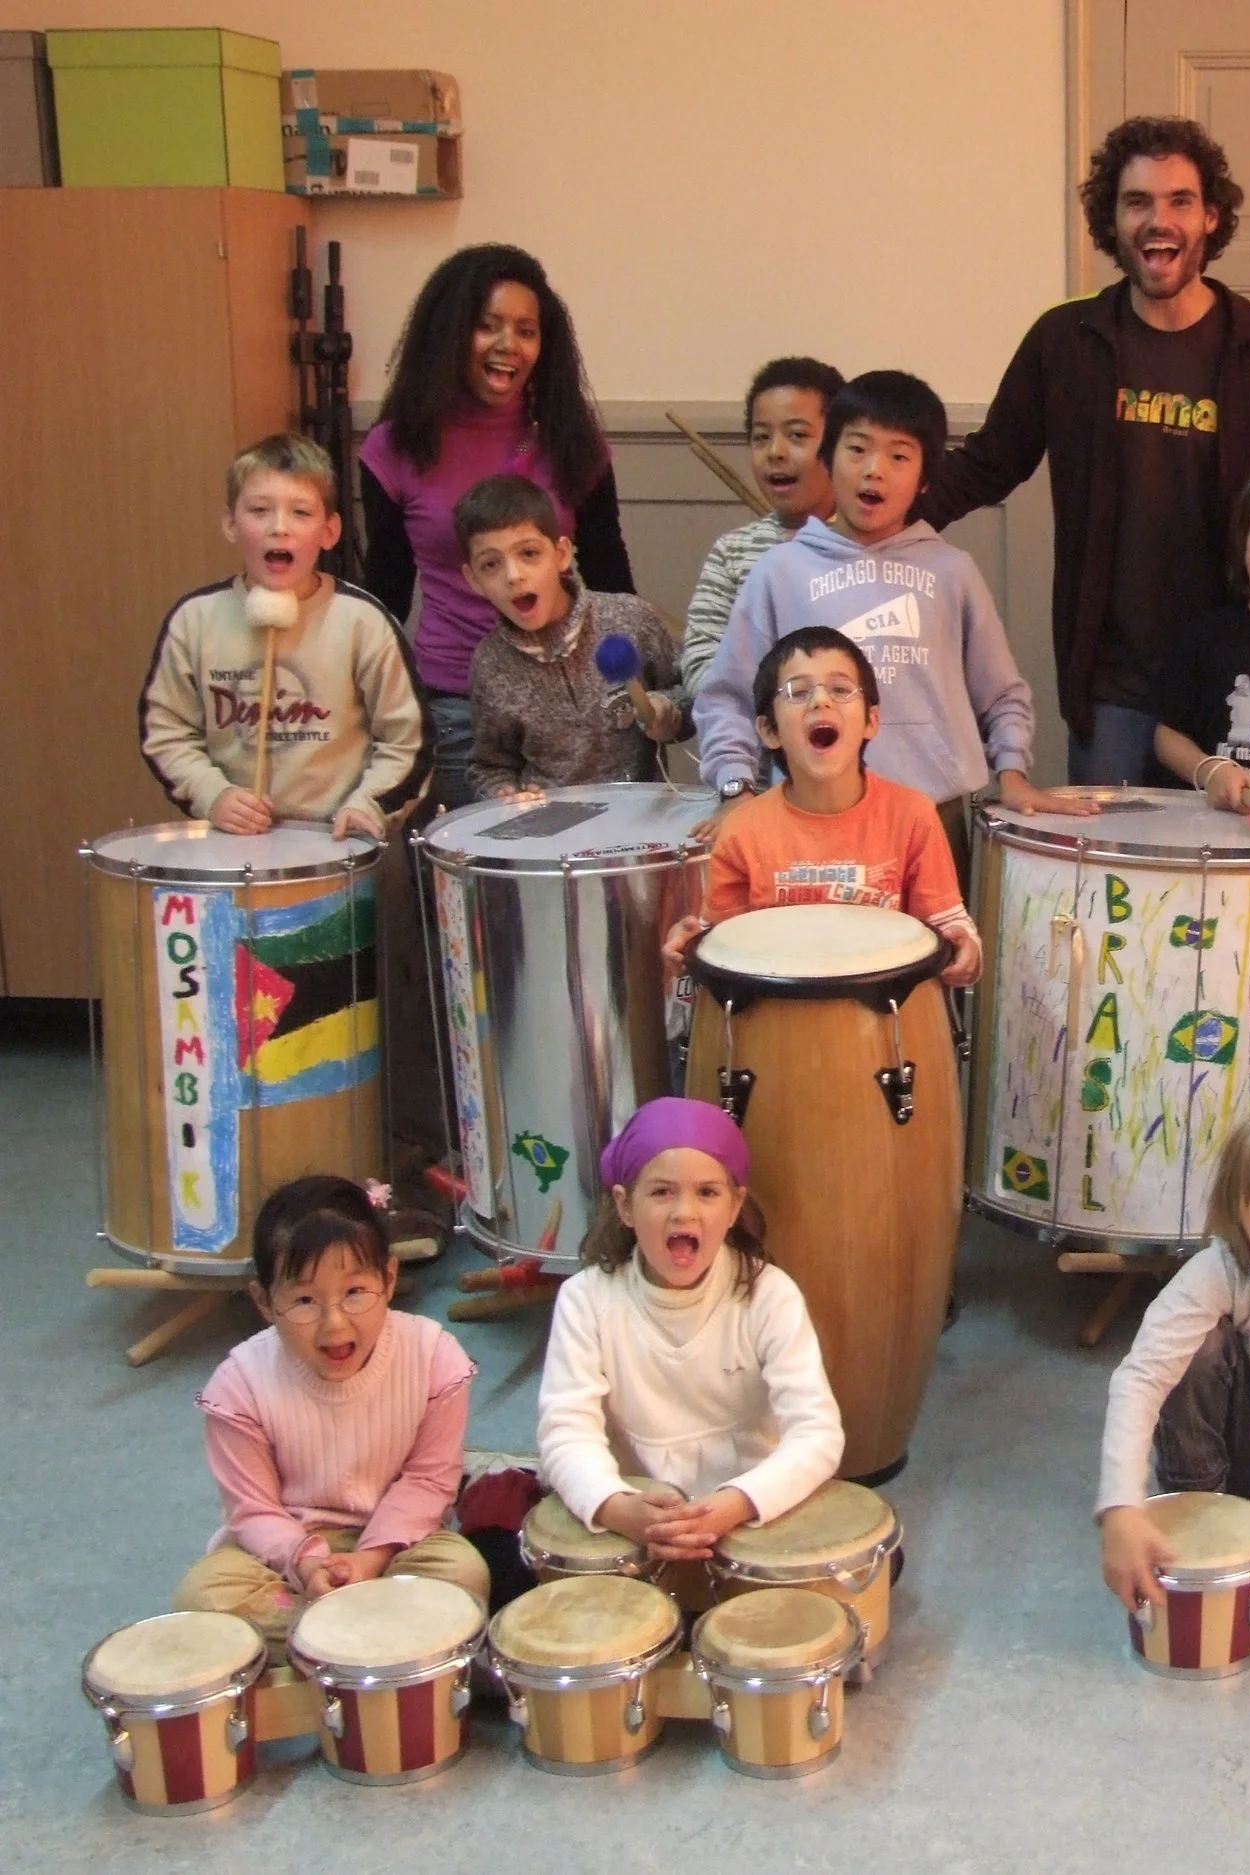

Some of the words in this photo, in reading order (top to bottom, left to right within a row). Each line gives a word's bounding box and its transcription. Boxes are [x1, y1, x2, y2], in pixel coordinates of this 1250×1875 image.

[1115, 388, 1218, 433] nima
[810, 560, 876, 602] CHICAGO
[882, 561, 936, 599] GROVE
[865, 611, 900, 631] CIA
[881, 645, 930, 666] AGENT
[161, 895, 207, 1208] MOSAMBIK
